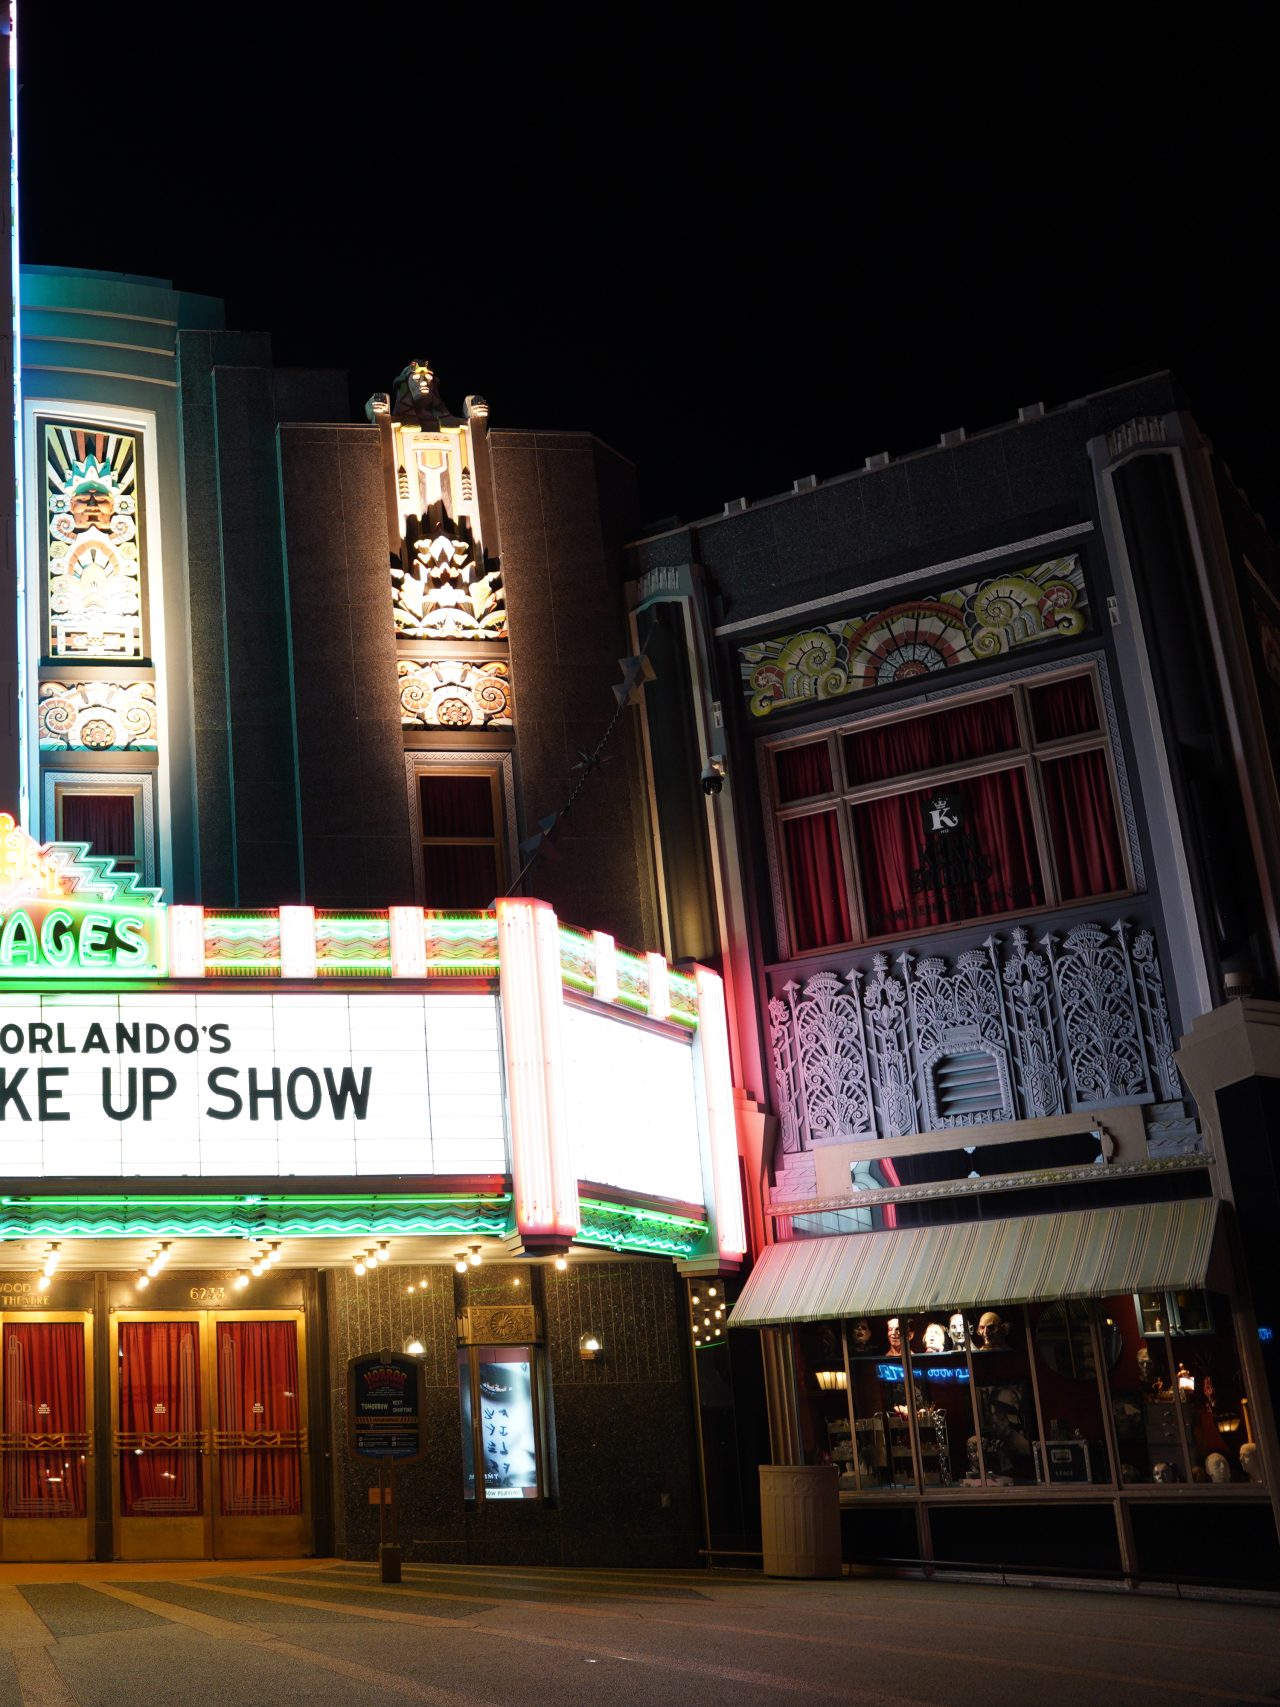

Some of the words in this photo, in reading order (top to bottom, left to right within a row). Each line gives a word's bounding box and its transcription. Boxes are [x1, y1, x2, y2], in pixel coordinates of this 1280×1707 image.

[929, 806, 959, 831] K
[0, 1023, 230, 1054] ORLANDO'S
[103, 1068, 176, 1120] UP
[207, 1067, 371, 1120] SHOW
[3, 1295, 50, 1306] THEATRE
[190, 1287, 225, 1300] 6233
